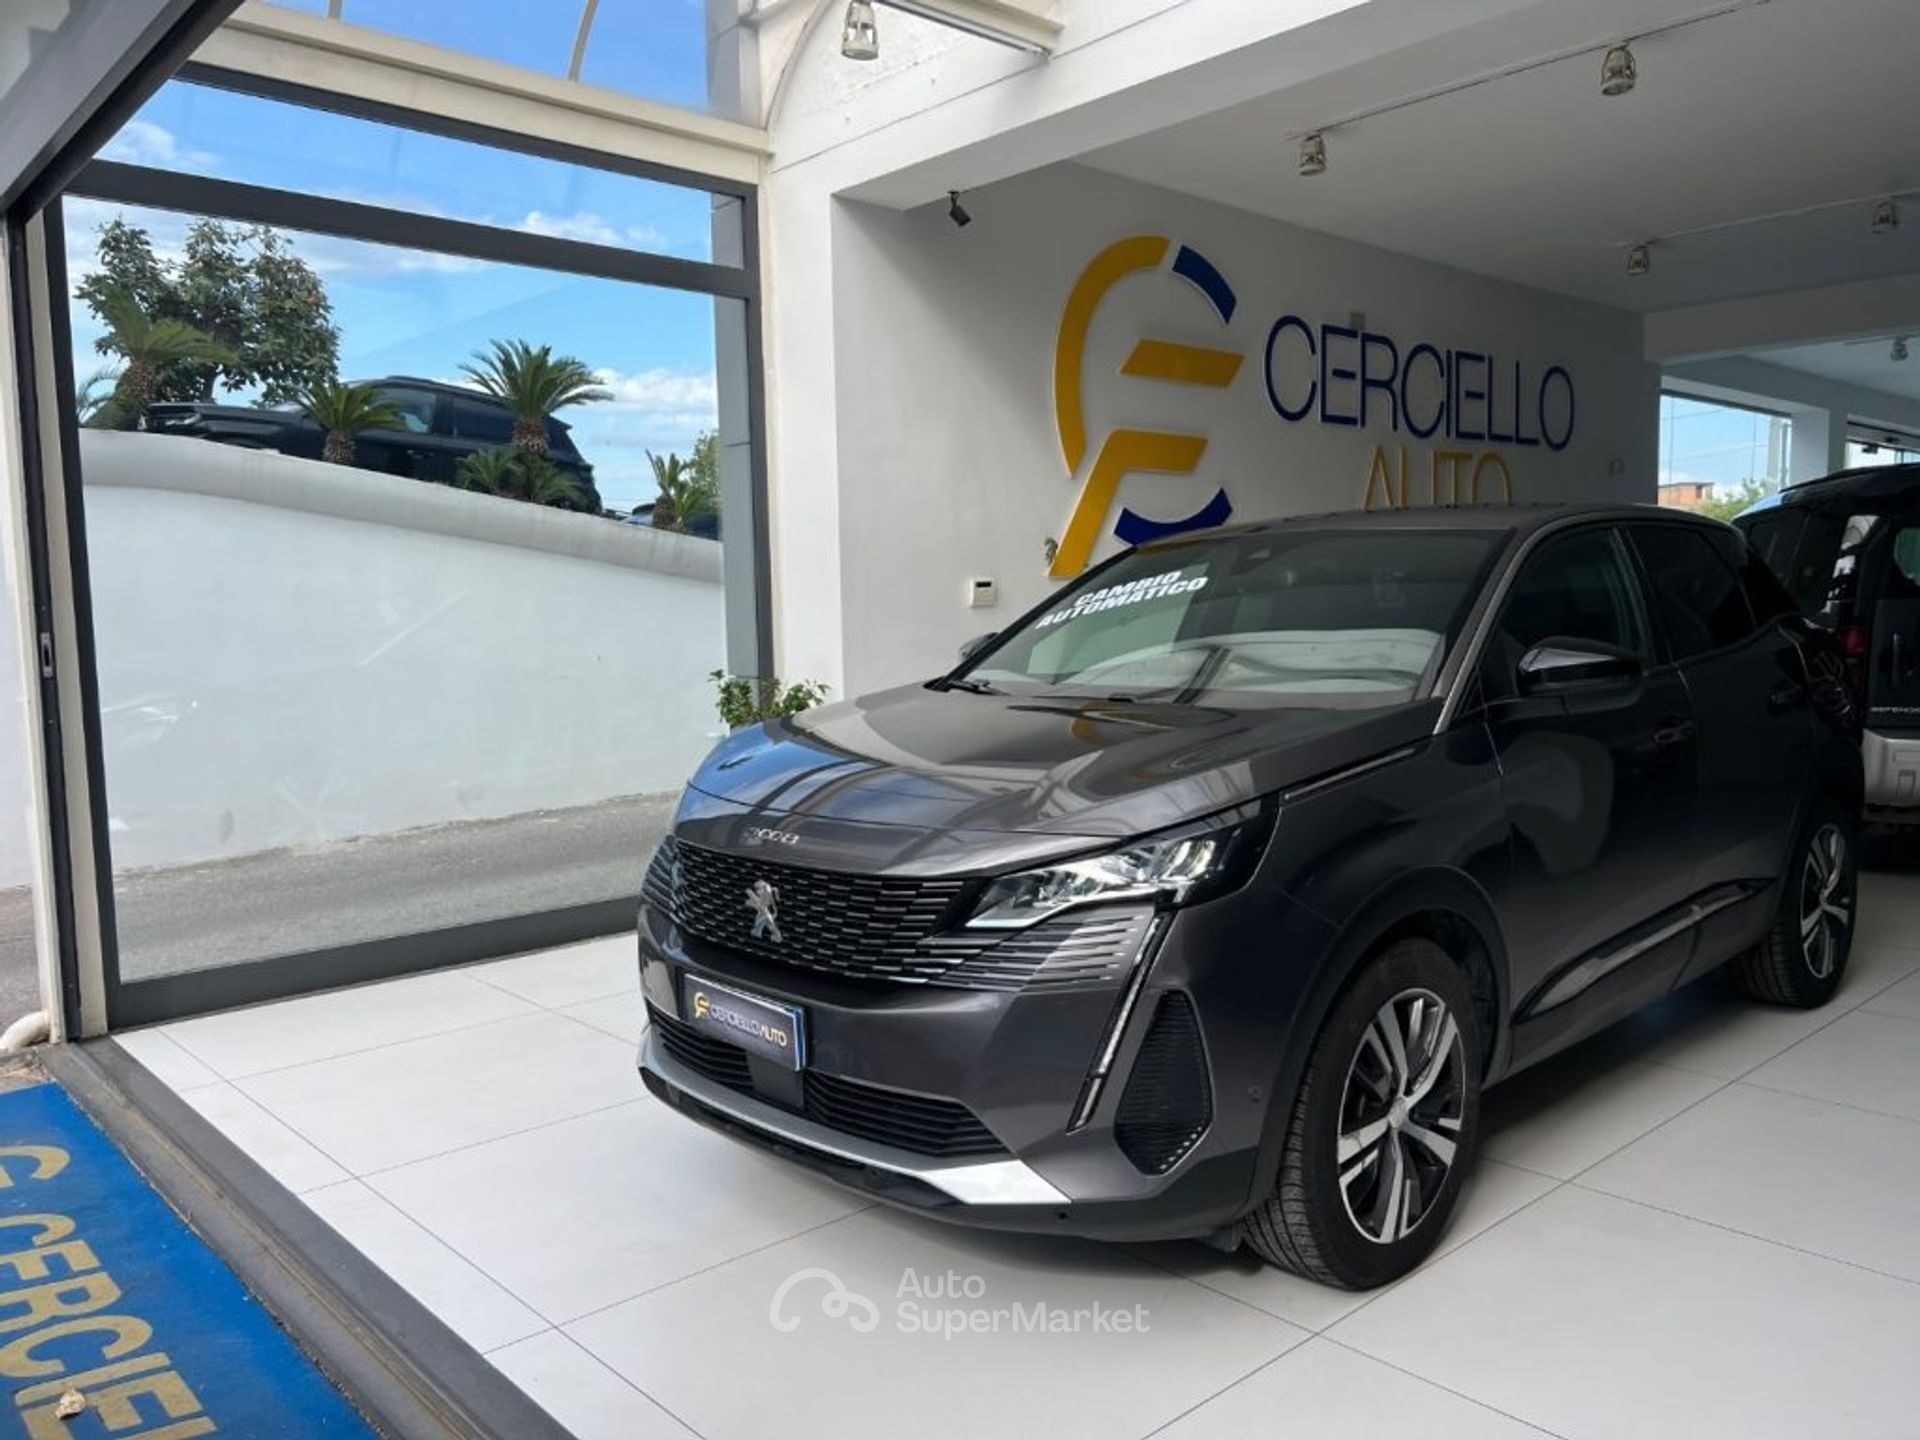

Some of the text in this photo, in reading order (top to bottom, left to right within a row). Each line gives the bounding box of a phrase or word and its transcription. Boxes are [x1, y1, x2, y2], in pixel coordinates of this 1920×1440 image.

[1263, 314, 1576, 452] CERCIELLO
[1363, 444, 1513, 511] AUTO
[1035, 577, 1209, 629] AUTOMATICO
[1073, 570, 1183, 607] CAMBIO
